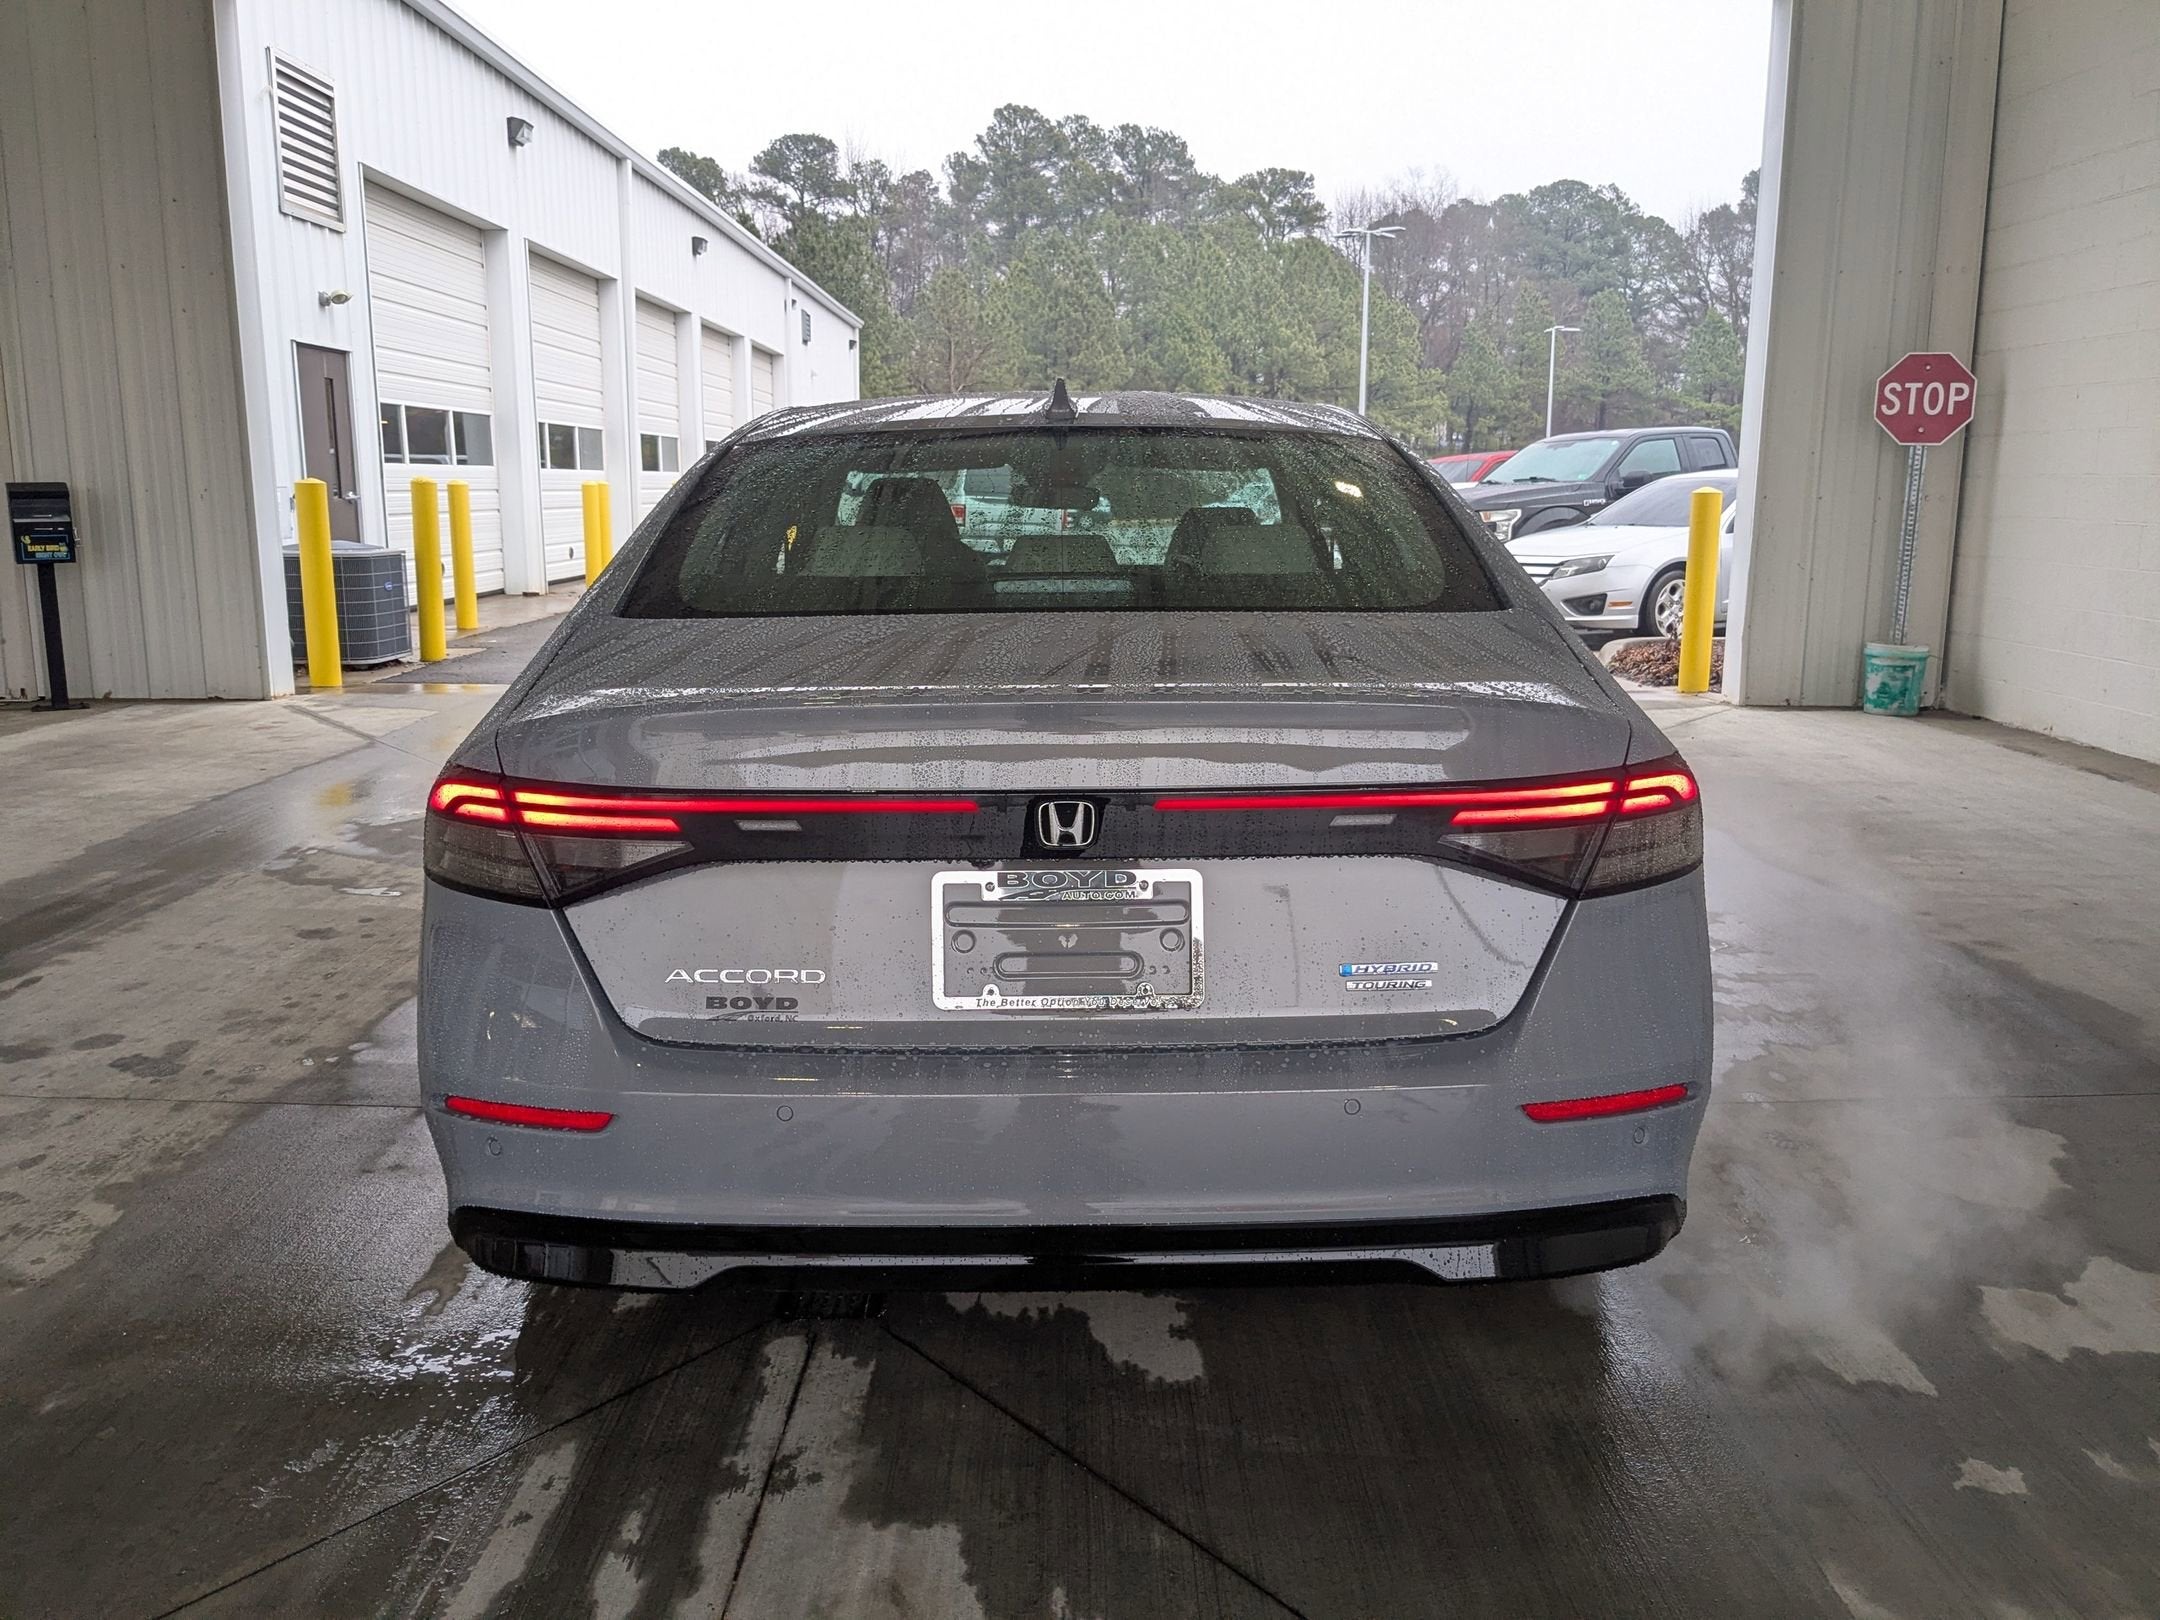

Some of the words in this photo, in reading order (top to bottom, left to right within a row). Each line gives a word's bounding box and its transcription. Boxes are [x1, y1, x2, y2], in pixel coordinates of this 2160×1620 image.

[1880, 381, 1970, 416] STOP
[997, 871, 1137, 888] BOYD
[1354, 963, 1433, 974] HYBRID
[665, 969, 826, 984] ACCORD
[1352, 981, 1427, 989] TOURING
[706, 996, 799, 1010] BOYD
[976, 998, 996, 1008] The
[1000, 998, 1037, 1008] Better
[785, 1014, 799, 1023] NC
